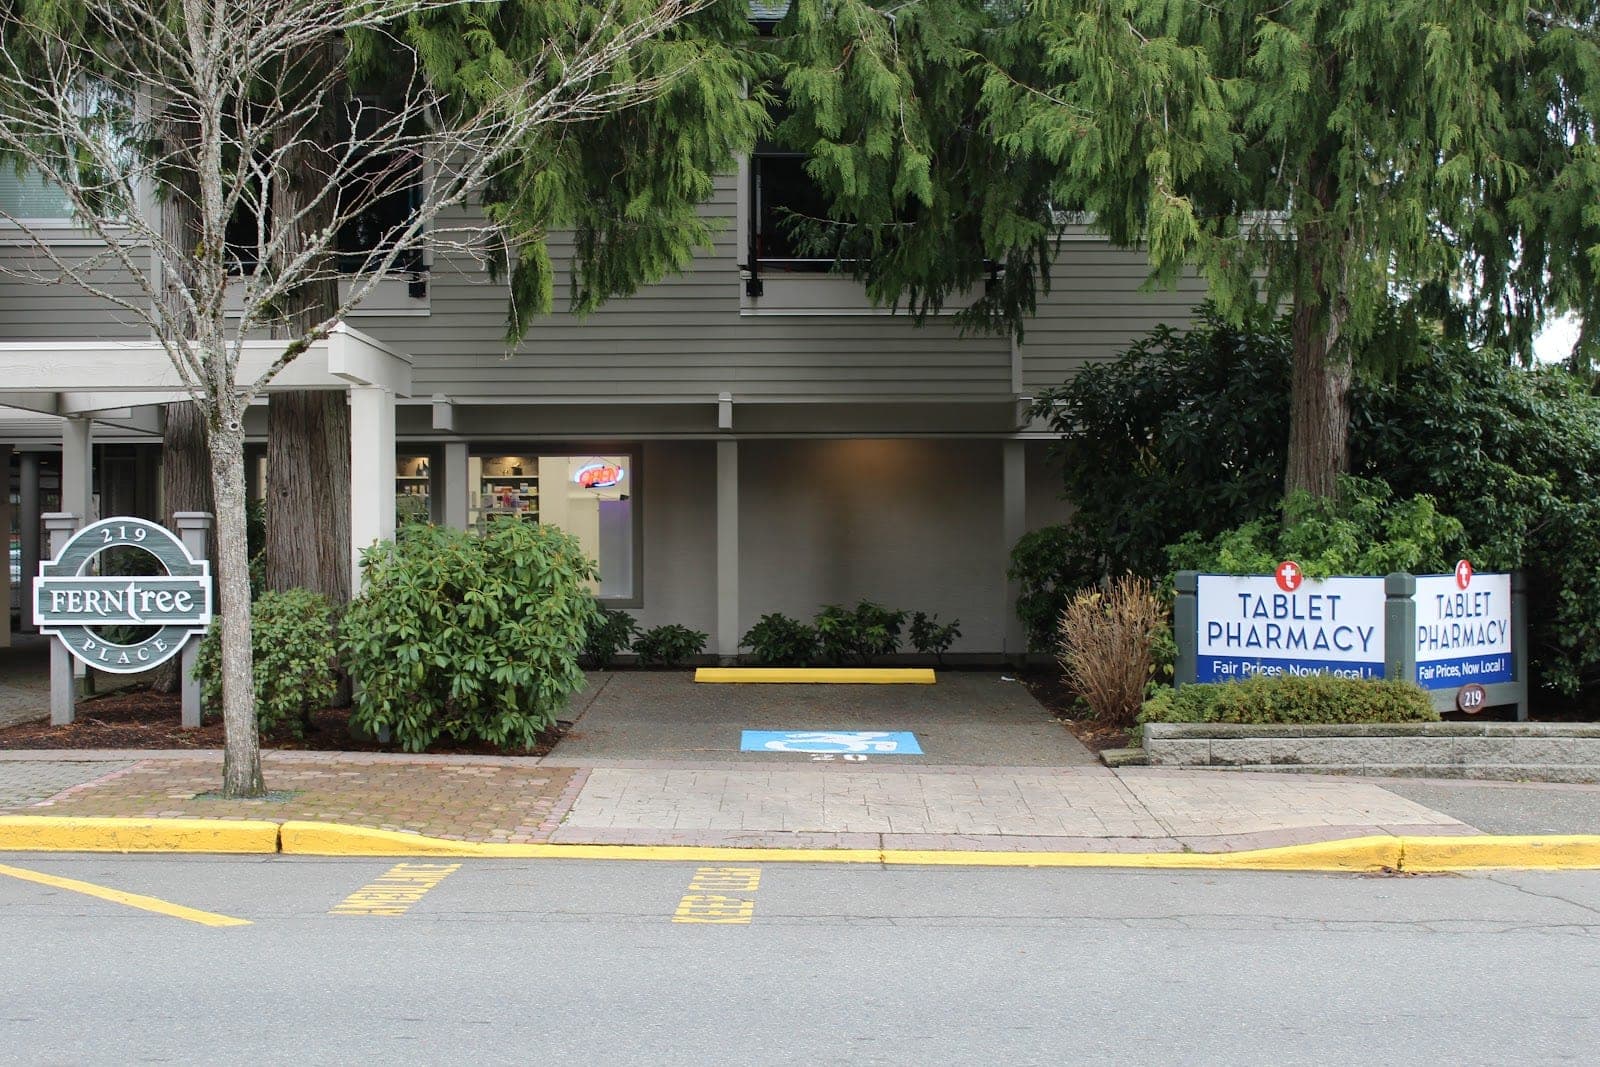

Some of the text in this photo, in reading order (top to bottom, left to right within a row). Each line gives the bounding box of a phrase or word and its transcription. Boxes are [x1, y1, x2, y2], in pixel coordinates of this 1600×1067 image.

[101, 526, 147, 543] 219
[50, 581, 194, 623] FERNtree
[1238, 593, 1341, 621] TABLET
[1436, 591, 1491, 619] TABLET
[1208, 621, 1374, 652] PHARMACY
[1418, 619, 1508, 652] PHARMACY
[82, 638, 168, 664] PLACE
[1213, 660, 1238, 674] Fair
[1289, 664, 1322, 677] Now
[1419, 665, 1435, 680] Fair
[1436, 664, 1461, 679] Prices,
[1462, 662, 1479, 676] Now
[1480, 659, 1500, 674] Local
[1464, 690, 1482, 707] 219
[326, 863, 463, 916] AMBULANCE
[671, 867, 762, 924] KEEP CLEAR
